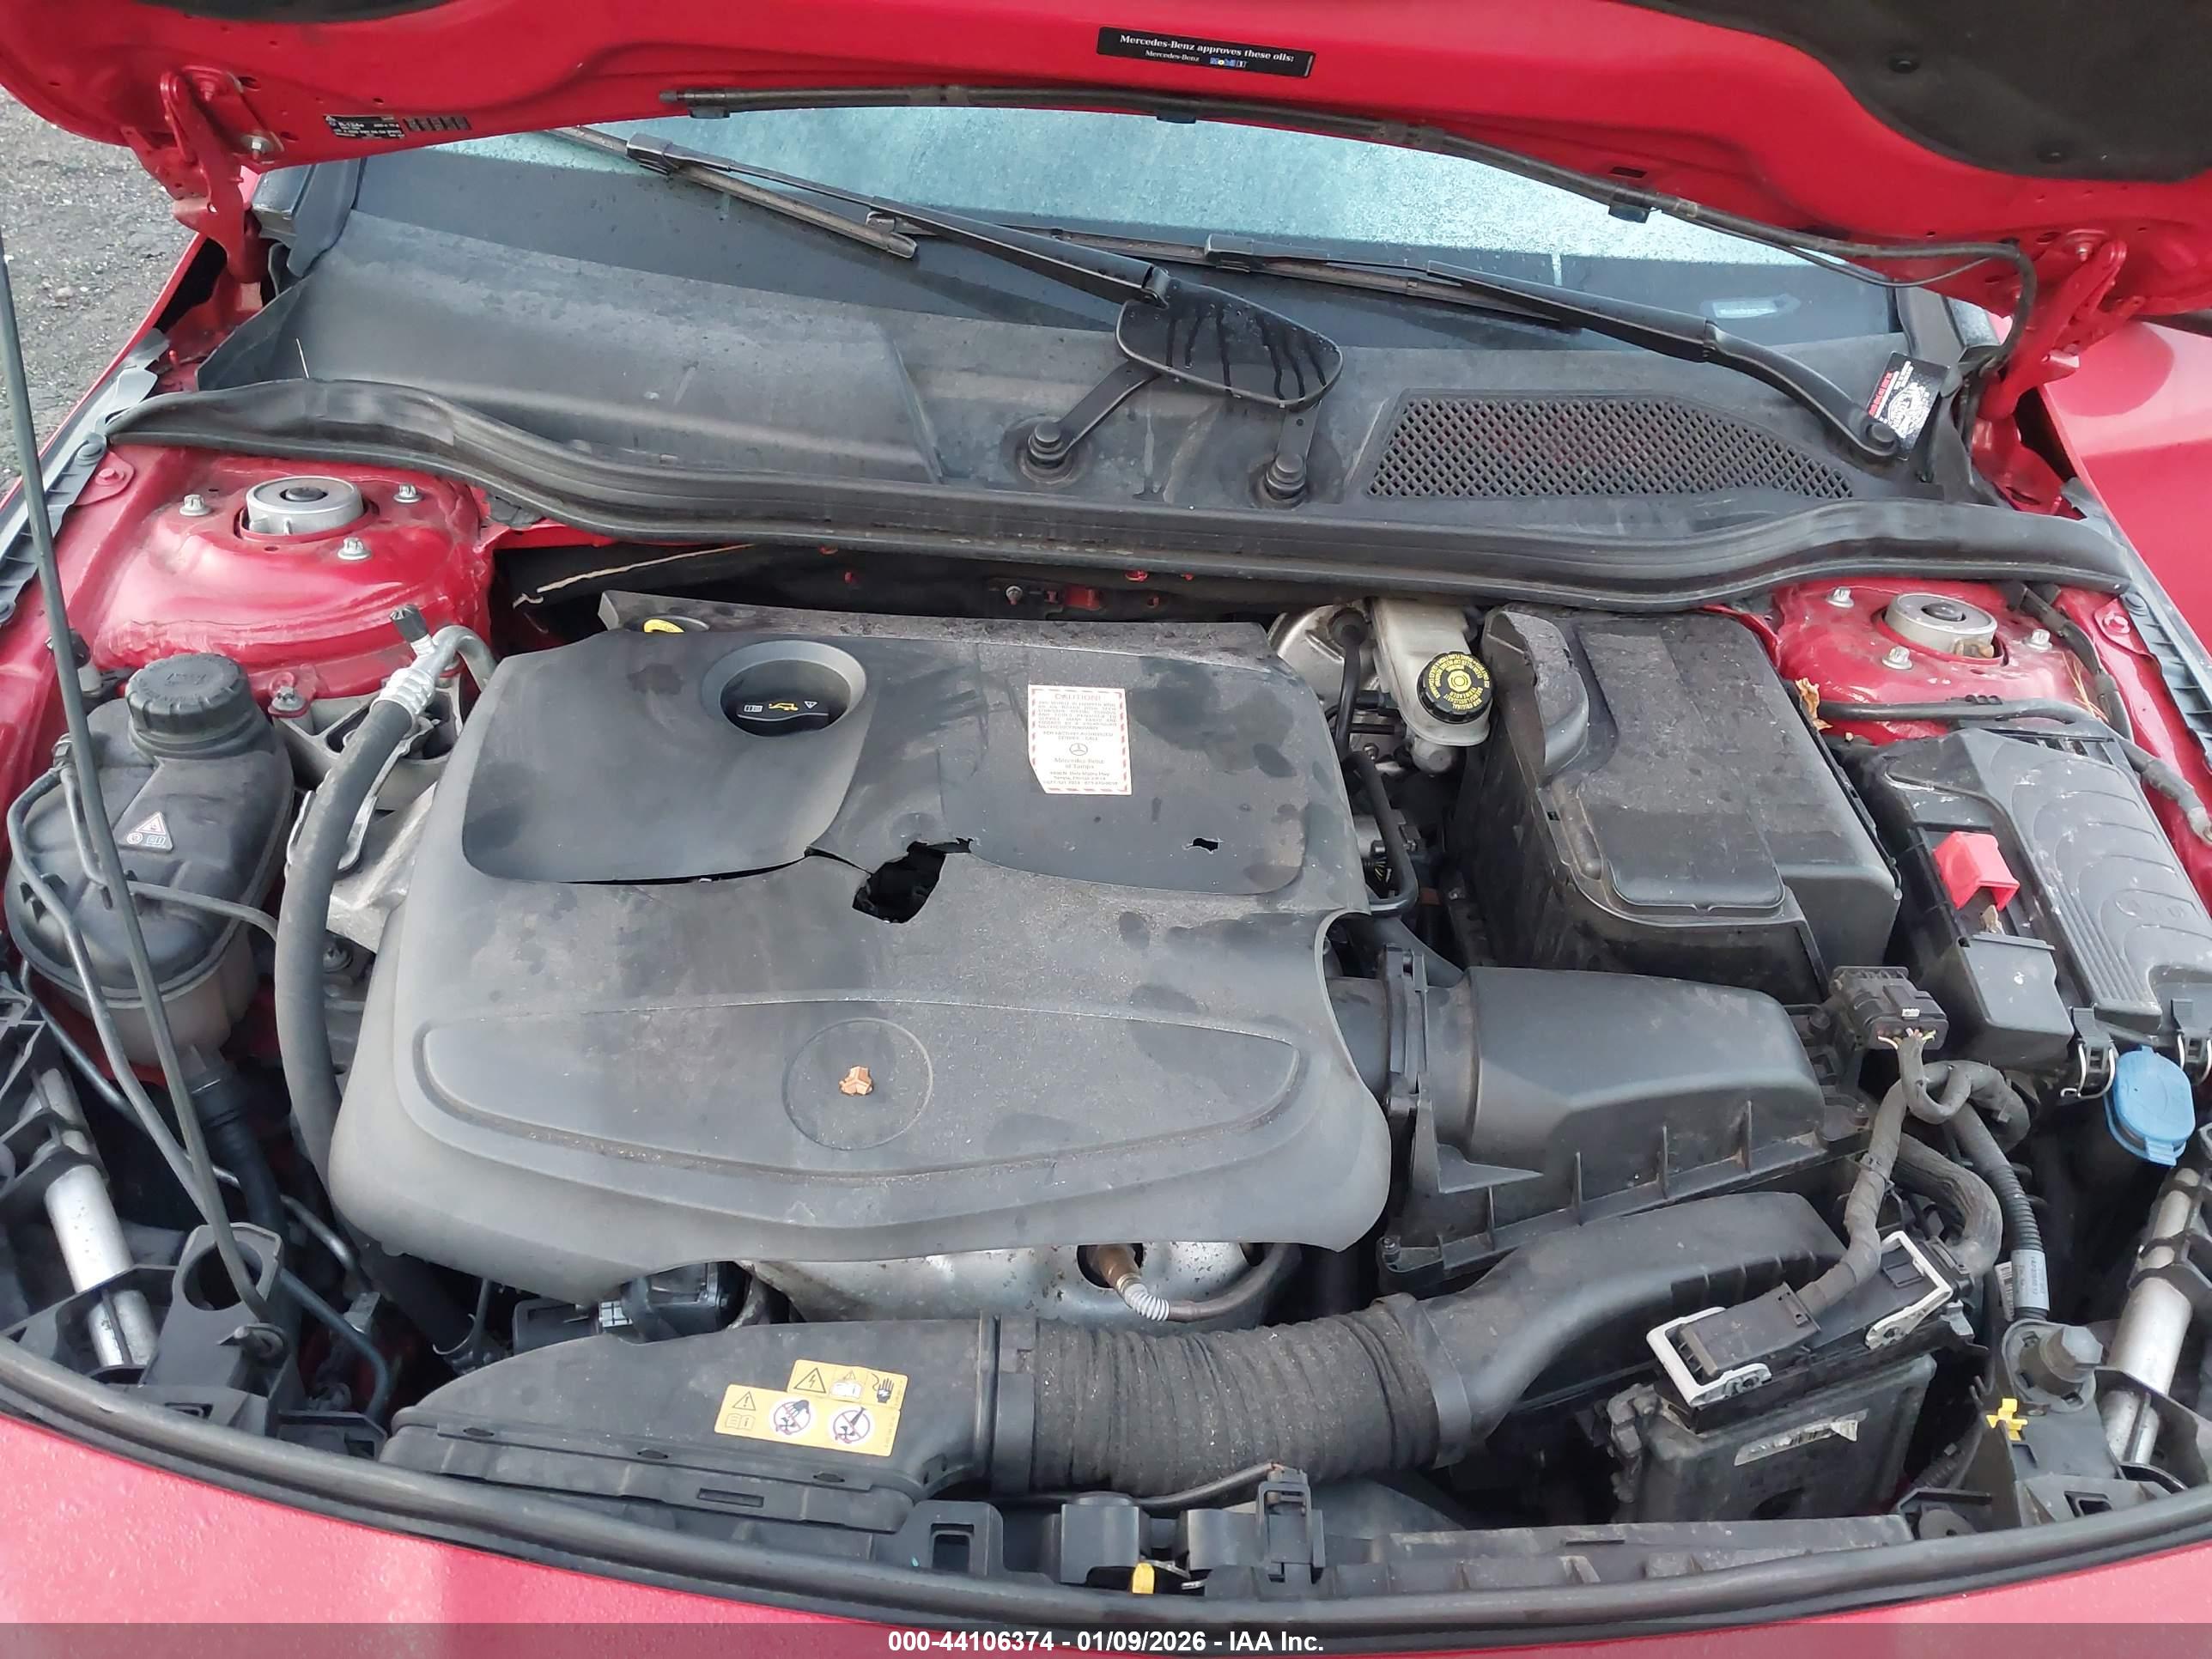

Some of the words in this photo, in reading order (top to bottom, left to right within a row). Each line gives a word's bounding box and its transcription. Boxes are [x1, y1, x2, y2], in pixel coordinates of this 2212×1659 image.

[1120, 34, 1194, 50] Mercedes-Benz
[1196, 45, 1242, 58] approves
[1244, 48, 1271, 59] these
[1273, 52, 1295, 63] oils:
[1146, 50, 1200, 63] Mercedes-Benz
[1054, 693, 1101, 702] CAUTION!
